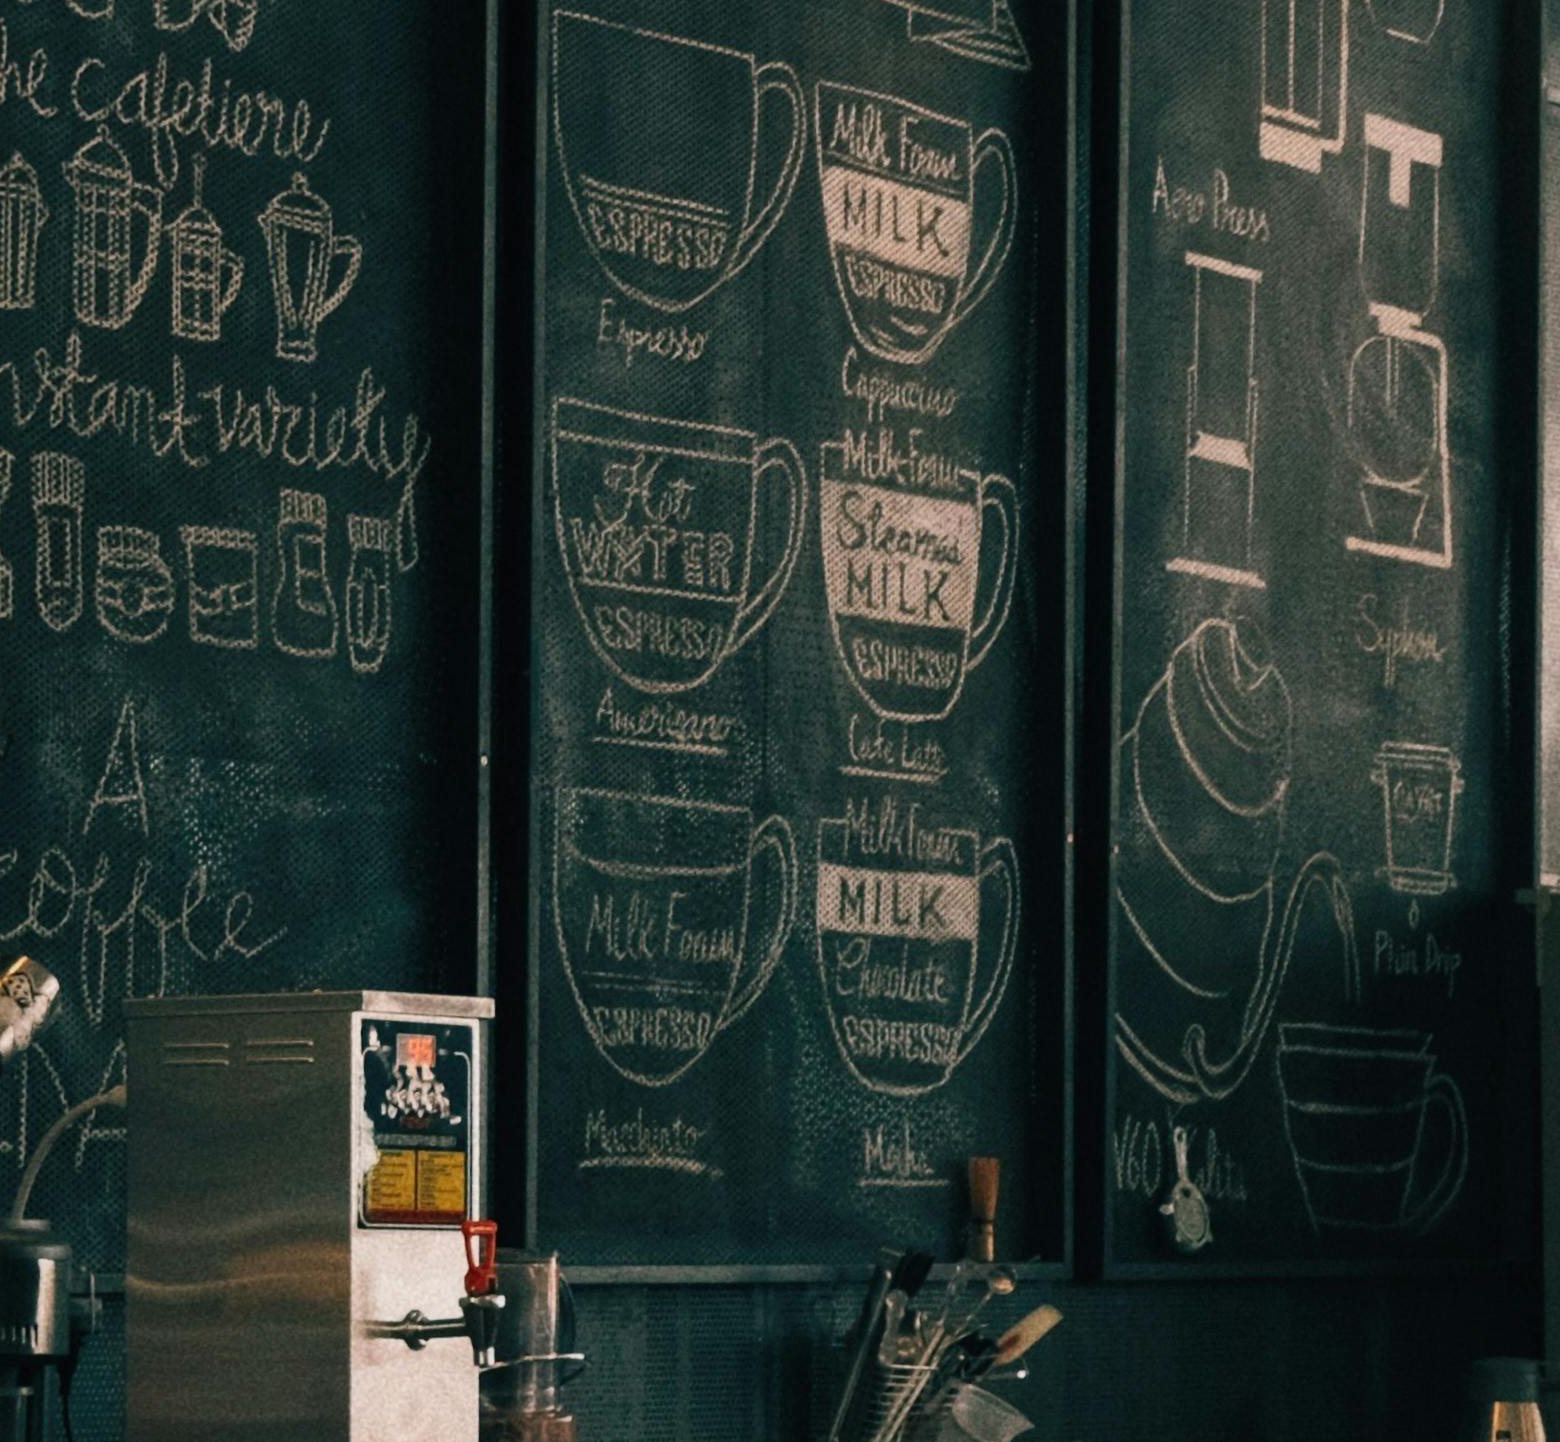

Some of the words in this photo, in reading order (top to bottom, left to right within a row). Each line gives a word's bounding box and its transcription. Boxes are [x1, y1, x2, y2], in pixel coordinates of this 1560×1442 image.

[830, 103, 891, 166] Milk
[586, 203, 728, 269] ESPRESSO
[842, 184, 951, 257] MILK
[1212, 168, 1271, 242] Press
[844, 254, 947, 313] ESPRESSO
[199, 367, 431, 572] variety
[843, 428, 904, 485] Milk
[594, 454, 696, 522] Hot
[570, 516, 735, 590] WATER
[847, 561, 951, 622] MILK
[597, 605, 726, 660] ESPRESSO
[853, 638, 960, 689] ESPRESSO
[82, 697, 150, 837] A
[844, 797, 905, 856] Milk
[585, 892, 656, 963] Milk
[838, 876, 947, 928] MILK
[592, 1006, 709, 1050] ESPRESSO
[841, 1015, 962, 1064] ESPRESSO
